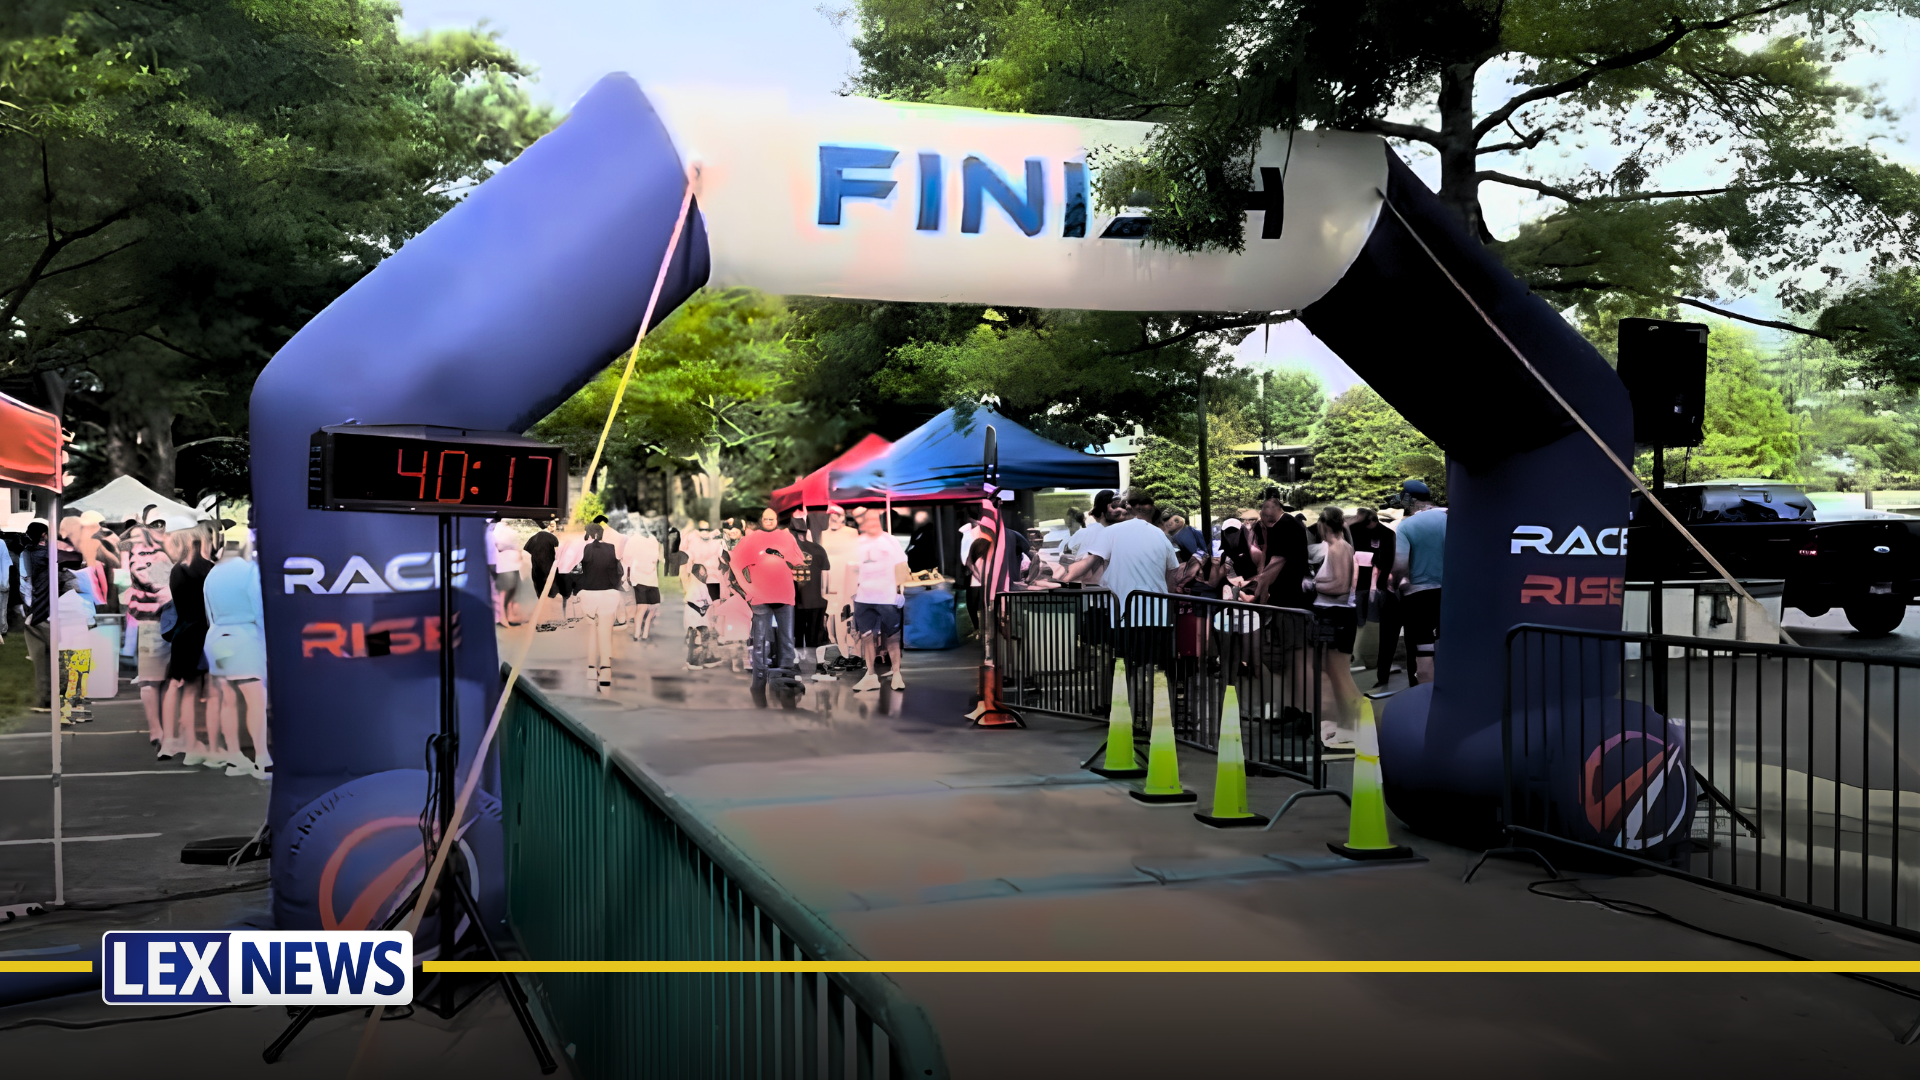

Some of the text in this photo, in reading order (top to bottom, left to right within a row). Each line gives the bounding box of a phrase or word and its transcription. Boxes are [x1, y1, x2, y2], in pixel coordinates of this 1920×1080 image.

[817, 143, 1285, 240] FINIH
[397, 449, 552, 506] 40:17
[283, 548, 468, 594] RACE
[302, 611, 462, 658] RISE
